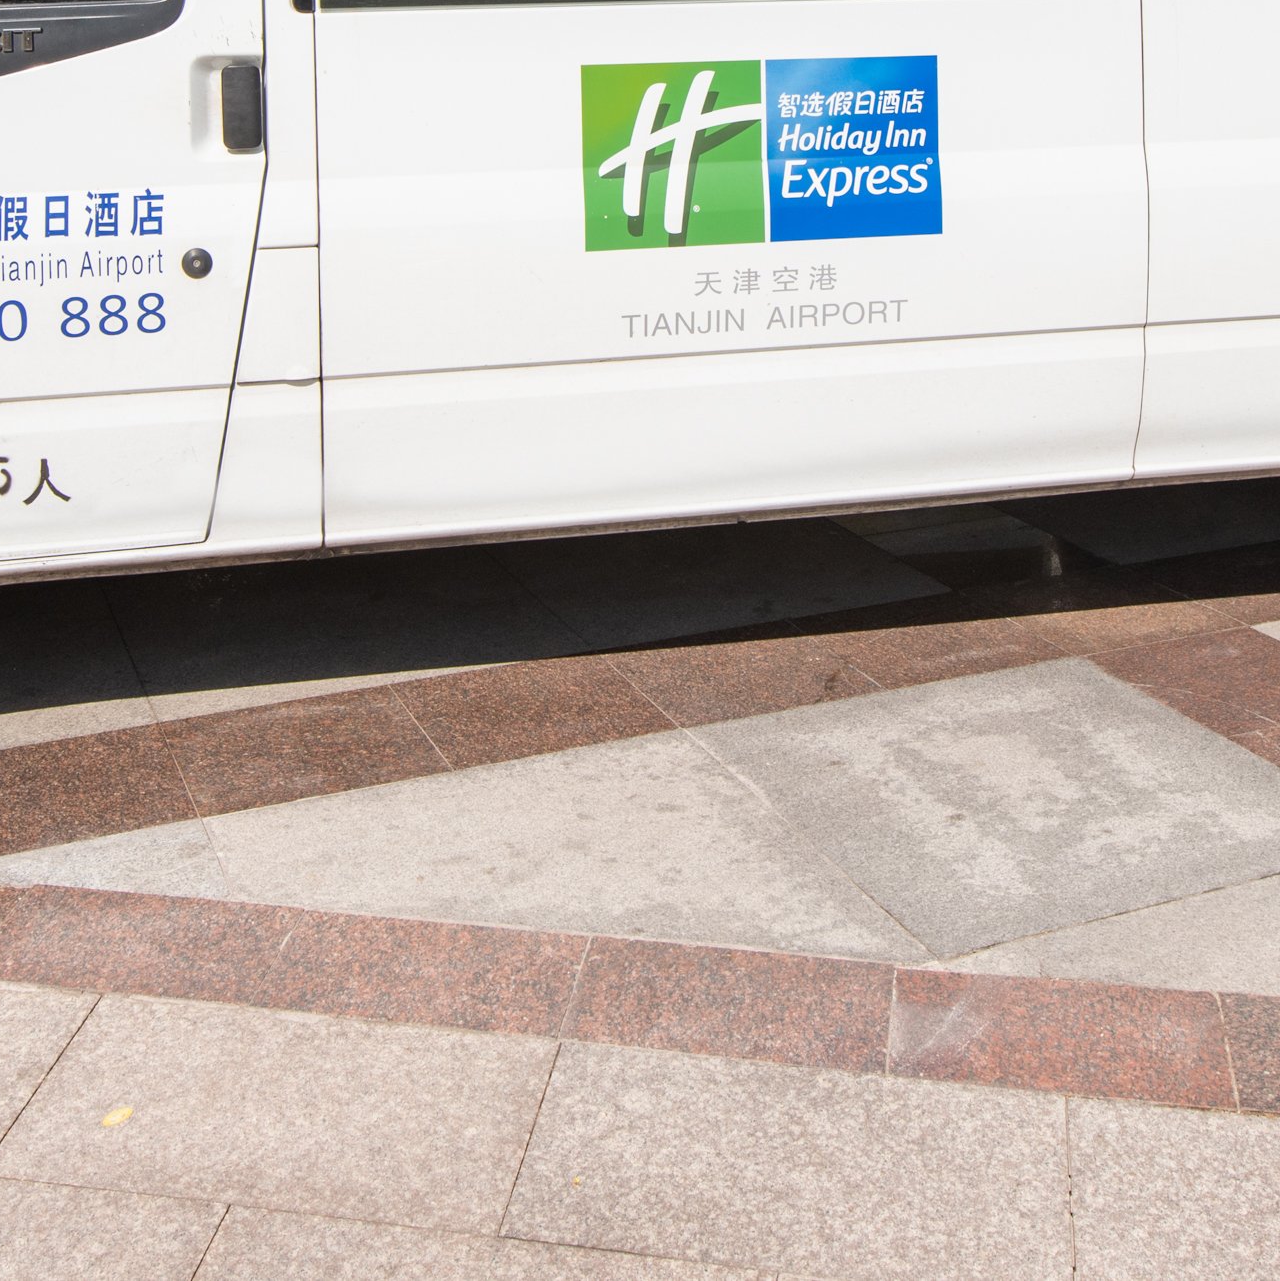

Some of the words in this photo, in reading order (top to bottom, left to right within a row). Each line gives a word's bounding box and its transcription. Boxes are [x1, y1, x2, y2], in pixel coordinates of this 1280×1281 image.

[777, 88, 925, 118] 智选假日酒店
[777, 122, 880, 155] Holiday
[885, 120, 927, 148] Inn
[781, 159, 929, 207] Express
[79, 249, 163, 283] Airport
[694, 263, 838, 297] 天津空港
[60, 292, 166, 338] 888
[621, 308, 745, 339] TIANJIN
[766, 299, 909, 330] AIRPORT
